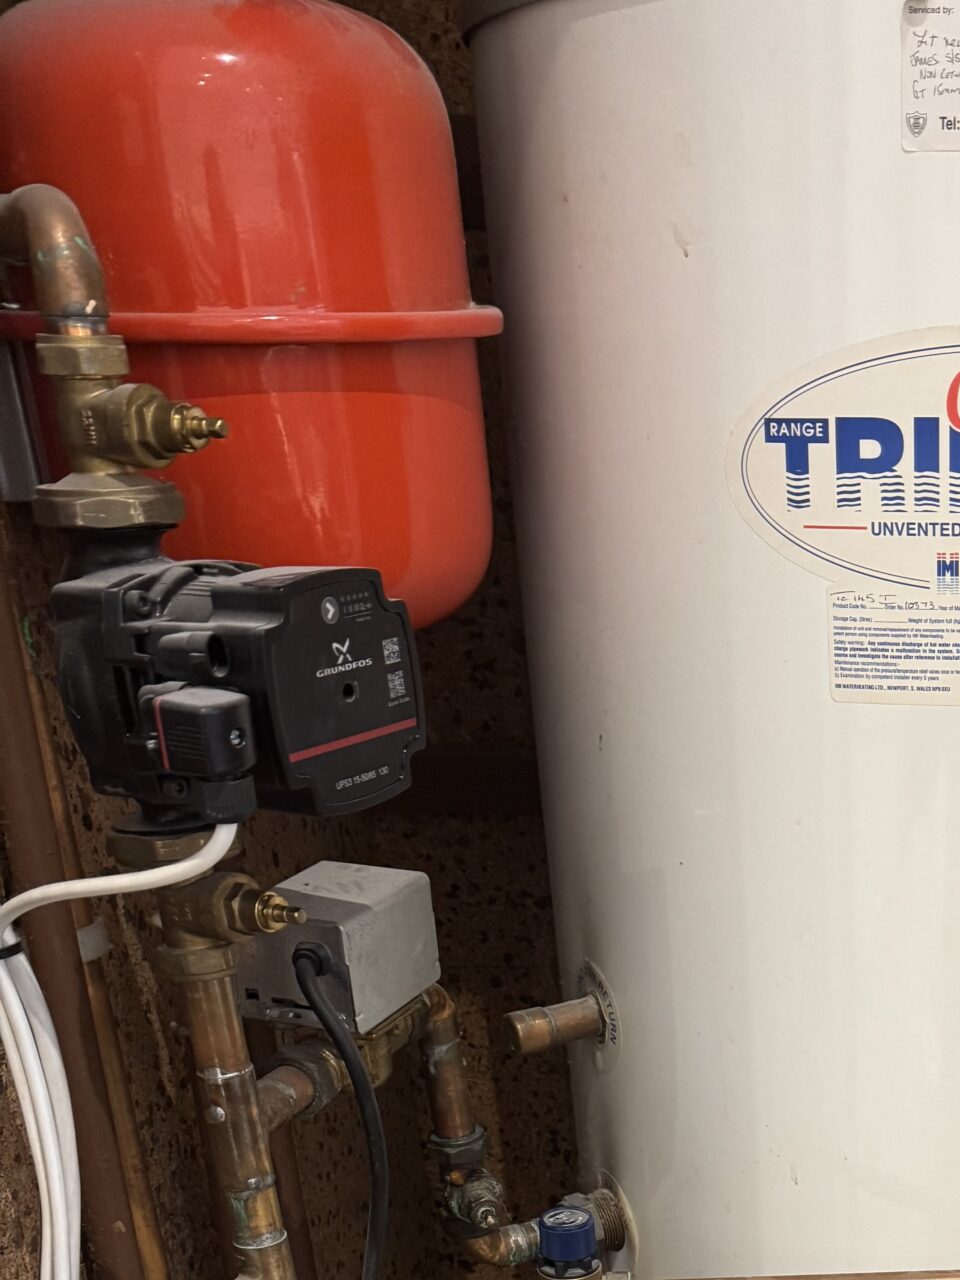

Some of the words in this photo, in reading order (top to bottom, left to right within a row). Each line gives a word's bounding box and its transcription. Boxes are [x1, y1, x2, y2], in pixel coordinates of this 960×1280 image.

[908, 6, 940, 14] Serviced
[943, 6, 954, 15] by:
[939, 117, 960, 131] Tel:
[770, 422, 824, 437] RANGE
[936, 554, 958, 578] IMI
[316, 657, 373, 678] GRUNDFOS
